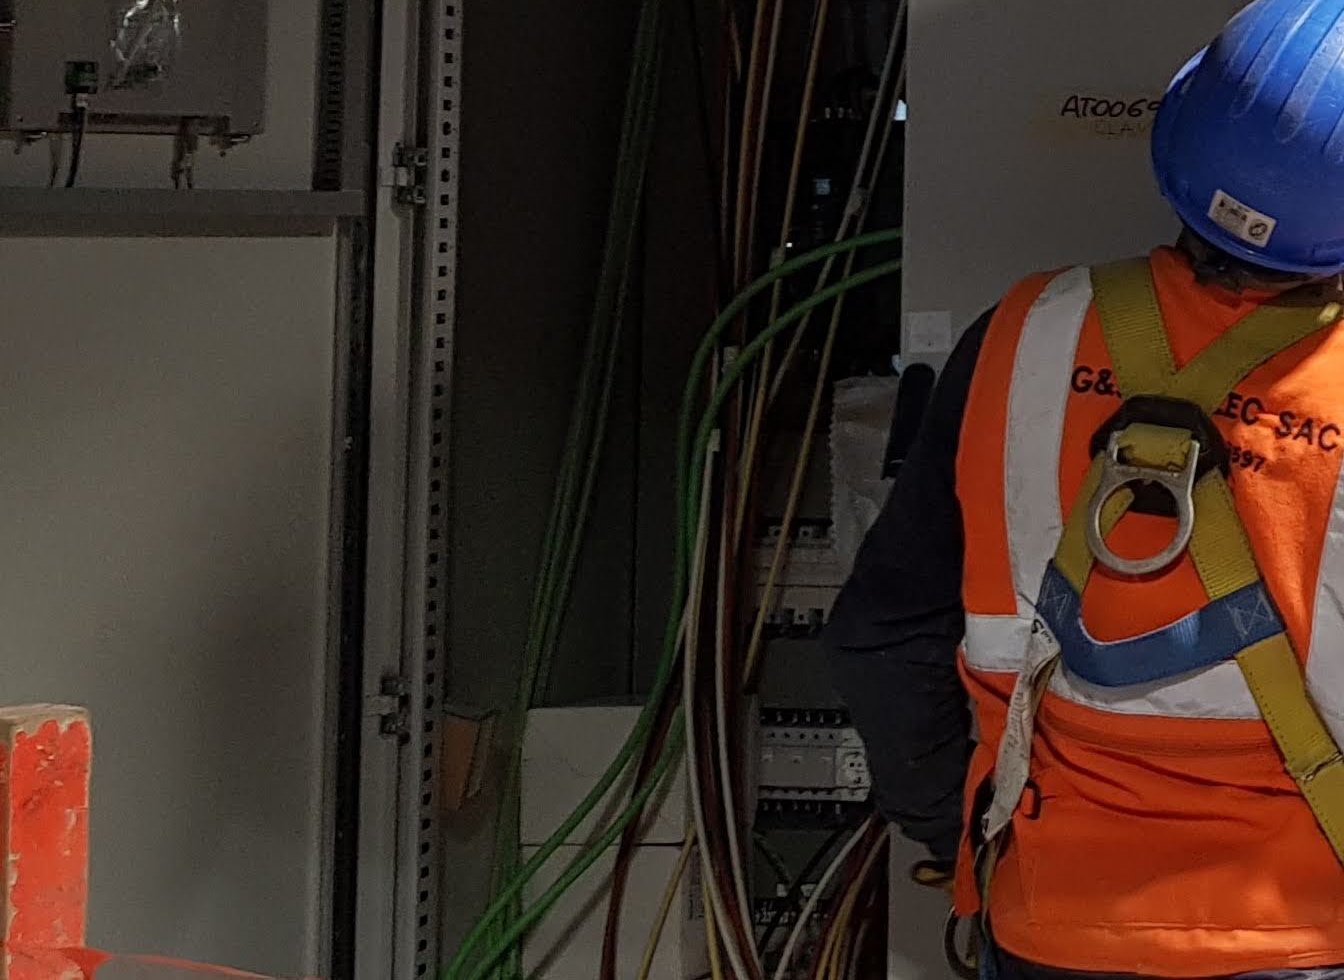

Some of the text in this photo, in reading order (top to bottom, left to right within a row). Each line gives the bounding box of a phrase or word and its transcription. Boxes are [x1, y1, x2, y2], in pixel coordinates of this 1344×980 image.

[1070, 365, 1122, 398] G&
[1274, 409, 1342, 451] SAC
[1229, 444, 1266, 472] 597
